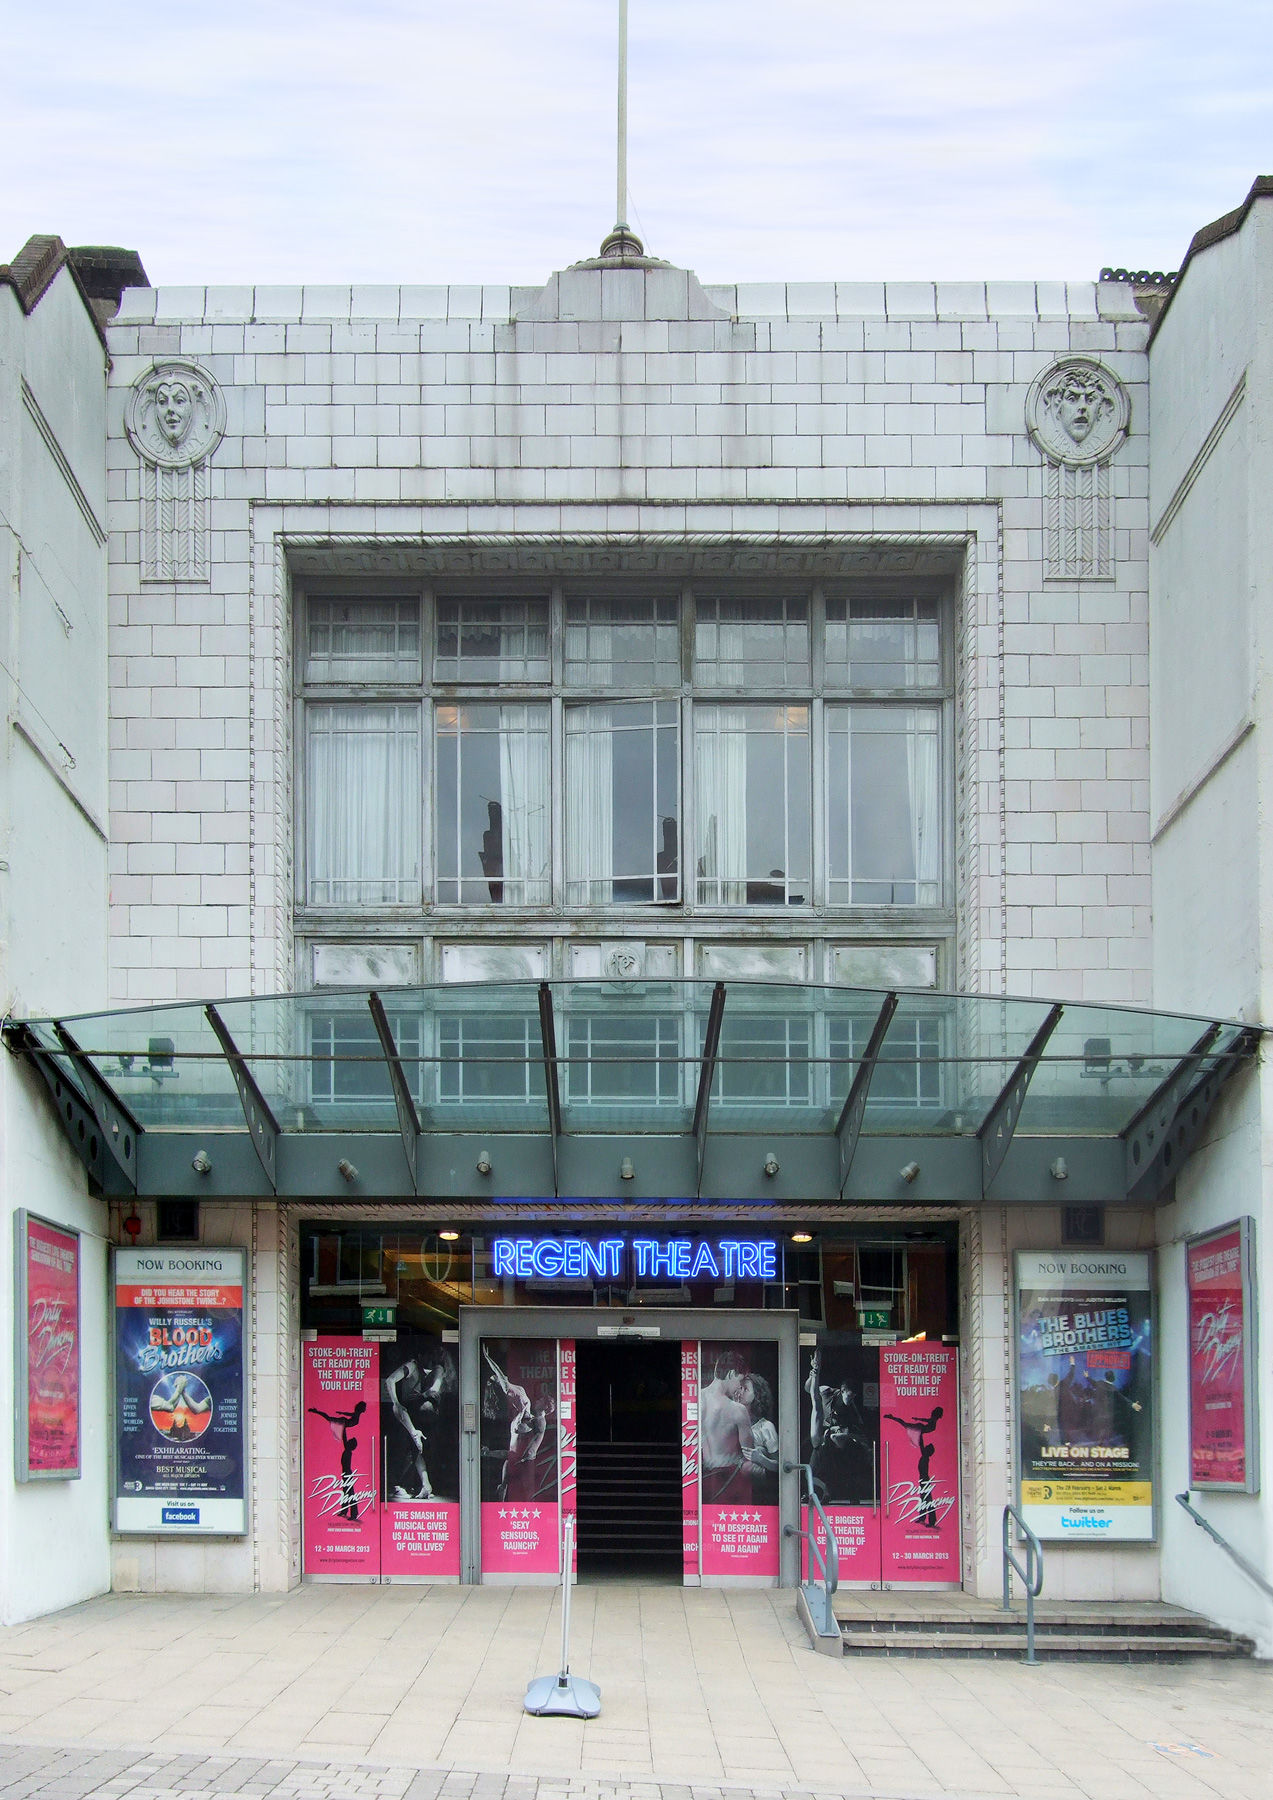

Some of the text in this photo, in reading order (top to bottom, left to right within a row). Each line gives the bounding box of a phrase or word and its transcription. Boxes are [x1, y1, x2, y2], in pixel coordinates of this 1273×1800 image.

[494, 1240, 776, 1278] REGENT THEATRE
[137, 1260, 222, 1270] NOW BOOKING
[1038, 1264, 1127, 1274] NOW BOOKING
[1038, 1308, 1129, 1333] THE BLUES
[150, 1328, 213, 1346] BLOOD
[1042, 1324, 1132, 1349] BROTHERS
[138, 1342, 223, 1372] Brothers
[309, 1348, 373, 1357] STOKE-ON-TRENT
[884, 1353, 949, 1362] STOKE-ON-TRENT
[313, 1359, 370, 1368] GET READY FOR
[888, 1364, 946, 1373] GET READY FOR
[318, 1370, 365, 1379] THE TIME OF
[893, 1376, 941, 1384] THE TIME OF
[321, 1381, 362, 1390] YOUR LIFE!
[897, 1387, 938, 1396] YOUR LIFE!
[1041, 1446, 1129, 1458] LIVE ON STAGE
[308, 1468, 368, 1498] Dirty
[885, 1475, 947, 1505] Dirty
[316, 1484, 377, 1519] Dancing
[894, 1491, 955, 1525] Dancing
[166, 1512, 196, 1520] facebook
[410, 1512, 435, 1520] SMASH
[437, 1512, 448, 1520] HIT
[835, 1516, 864, 1524] BIGGEST
[395, 1522, 447, 1530] MUSICAL GIVES
[1062, 1516, 1112, 1528] twitter
[728, 1524, 767, 1533] DESPERATE
[835, 1526, 864, 1534] THEATRE
[392, 1532, 449, 1540] US ALL THE TIME
[501, 1531, 539, 1540] SENSUOUS,
[712, 1534, 767, 1542] TO SEE IT AGAIN
[856, 1537, 866, 1545] OF
[397, 1543, 406, 1551] OF
[408, 1543, 422, 1551] OUR
[721, 1545, 735, 1553] AND
